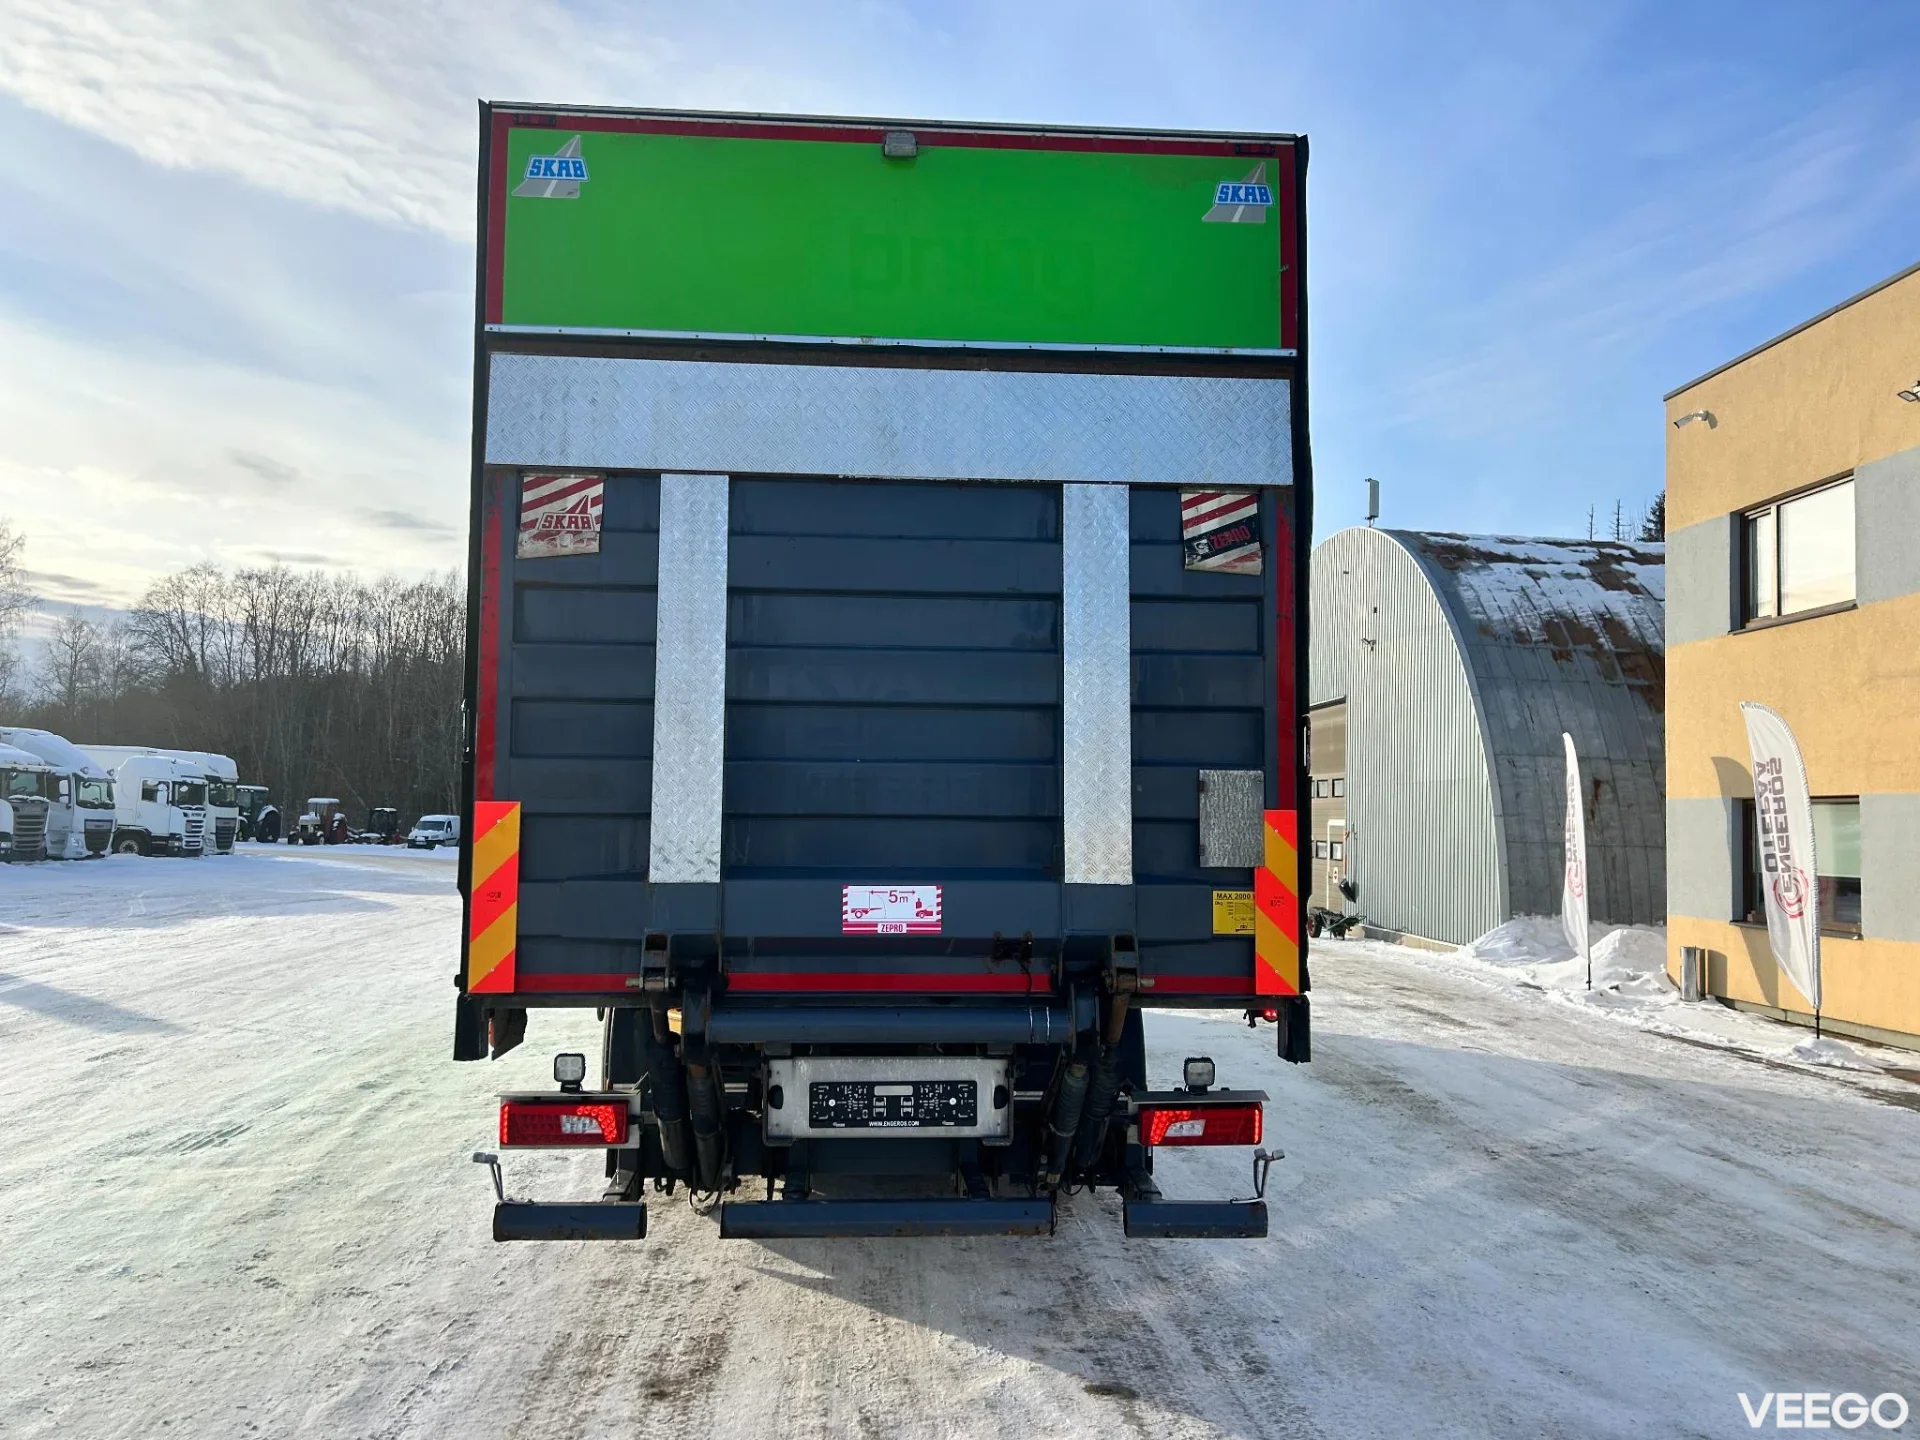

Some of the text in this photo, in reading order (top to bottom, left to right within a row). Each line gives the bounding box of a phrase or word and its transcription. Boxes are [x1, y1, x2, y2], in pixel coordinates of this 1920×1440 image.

[529, 158, 586, 178] SKAB
[1217, 184, 1272, 203] SKAB
[541, 514, 592, 530] SKAB
[888, 890, 909, 903] 5 m
[1216, 892, 1233, 900] MAX
[1234, 892, 1251, 900] 2000
[881, 924, 904, 933] ZEPRO
